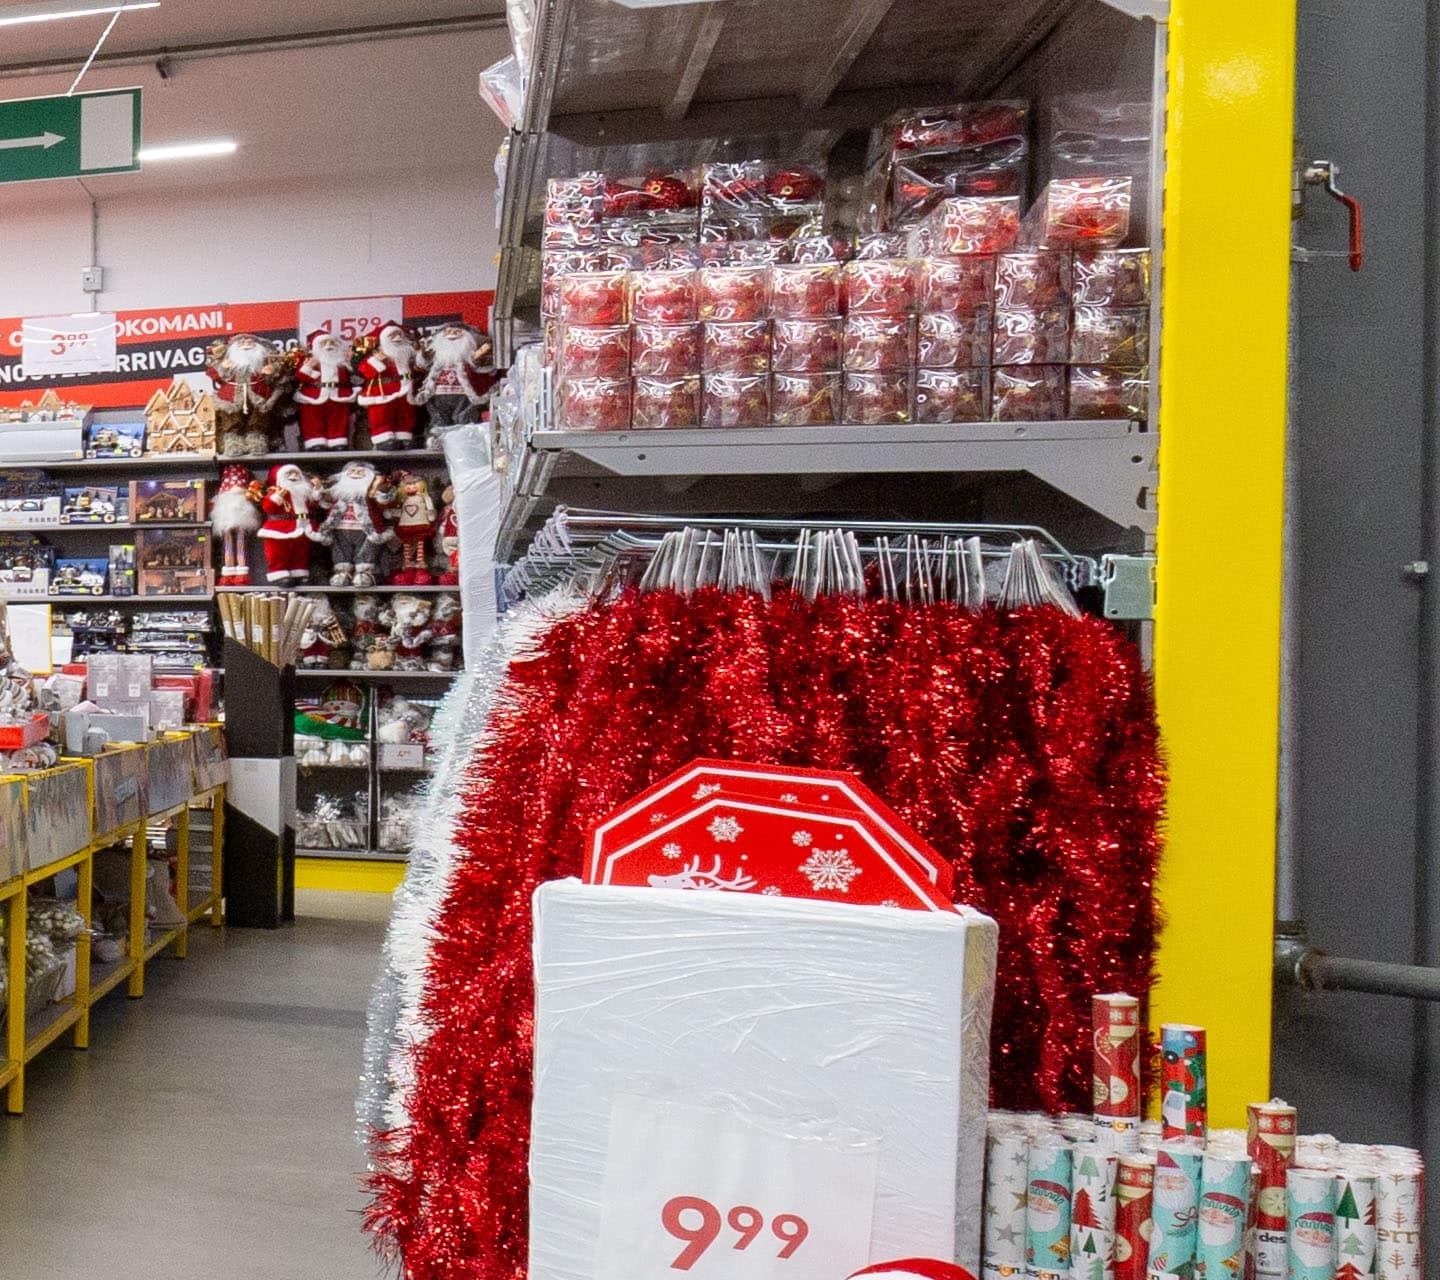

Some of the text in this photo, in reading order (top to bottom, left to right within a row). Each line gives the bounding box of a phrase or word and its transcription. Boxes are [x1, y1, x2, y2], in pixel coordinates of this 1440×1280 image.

[117, 347, 211, 372] RRIVAG
[661, 1196, 809, 1270] 999
[1259, 1231, 1286, 1244] des
